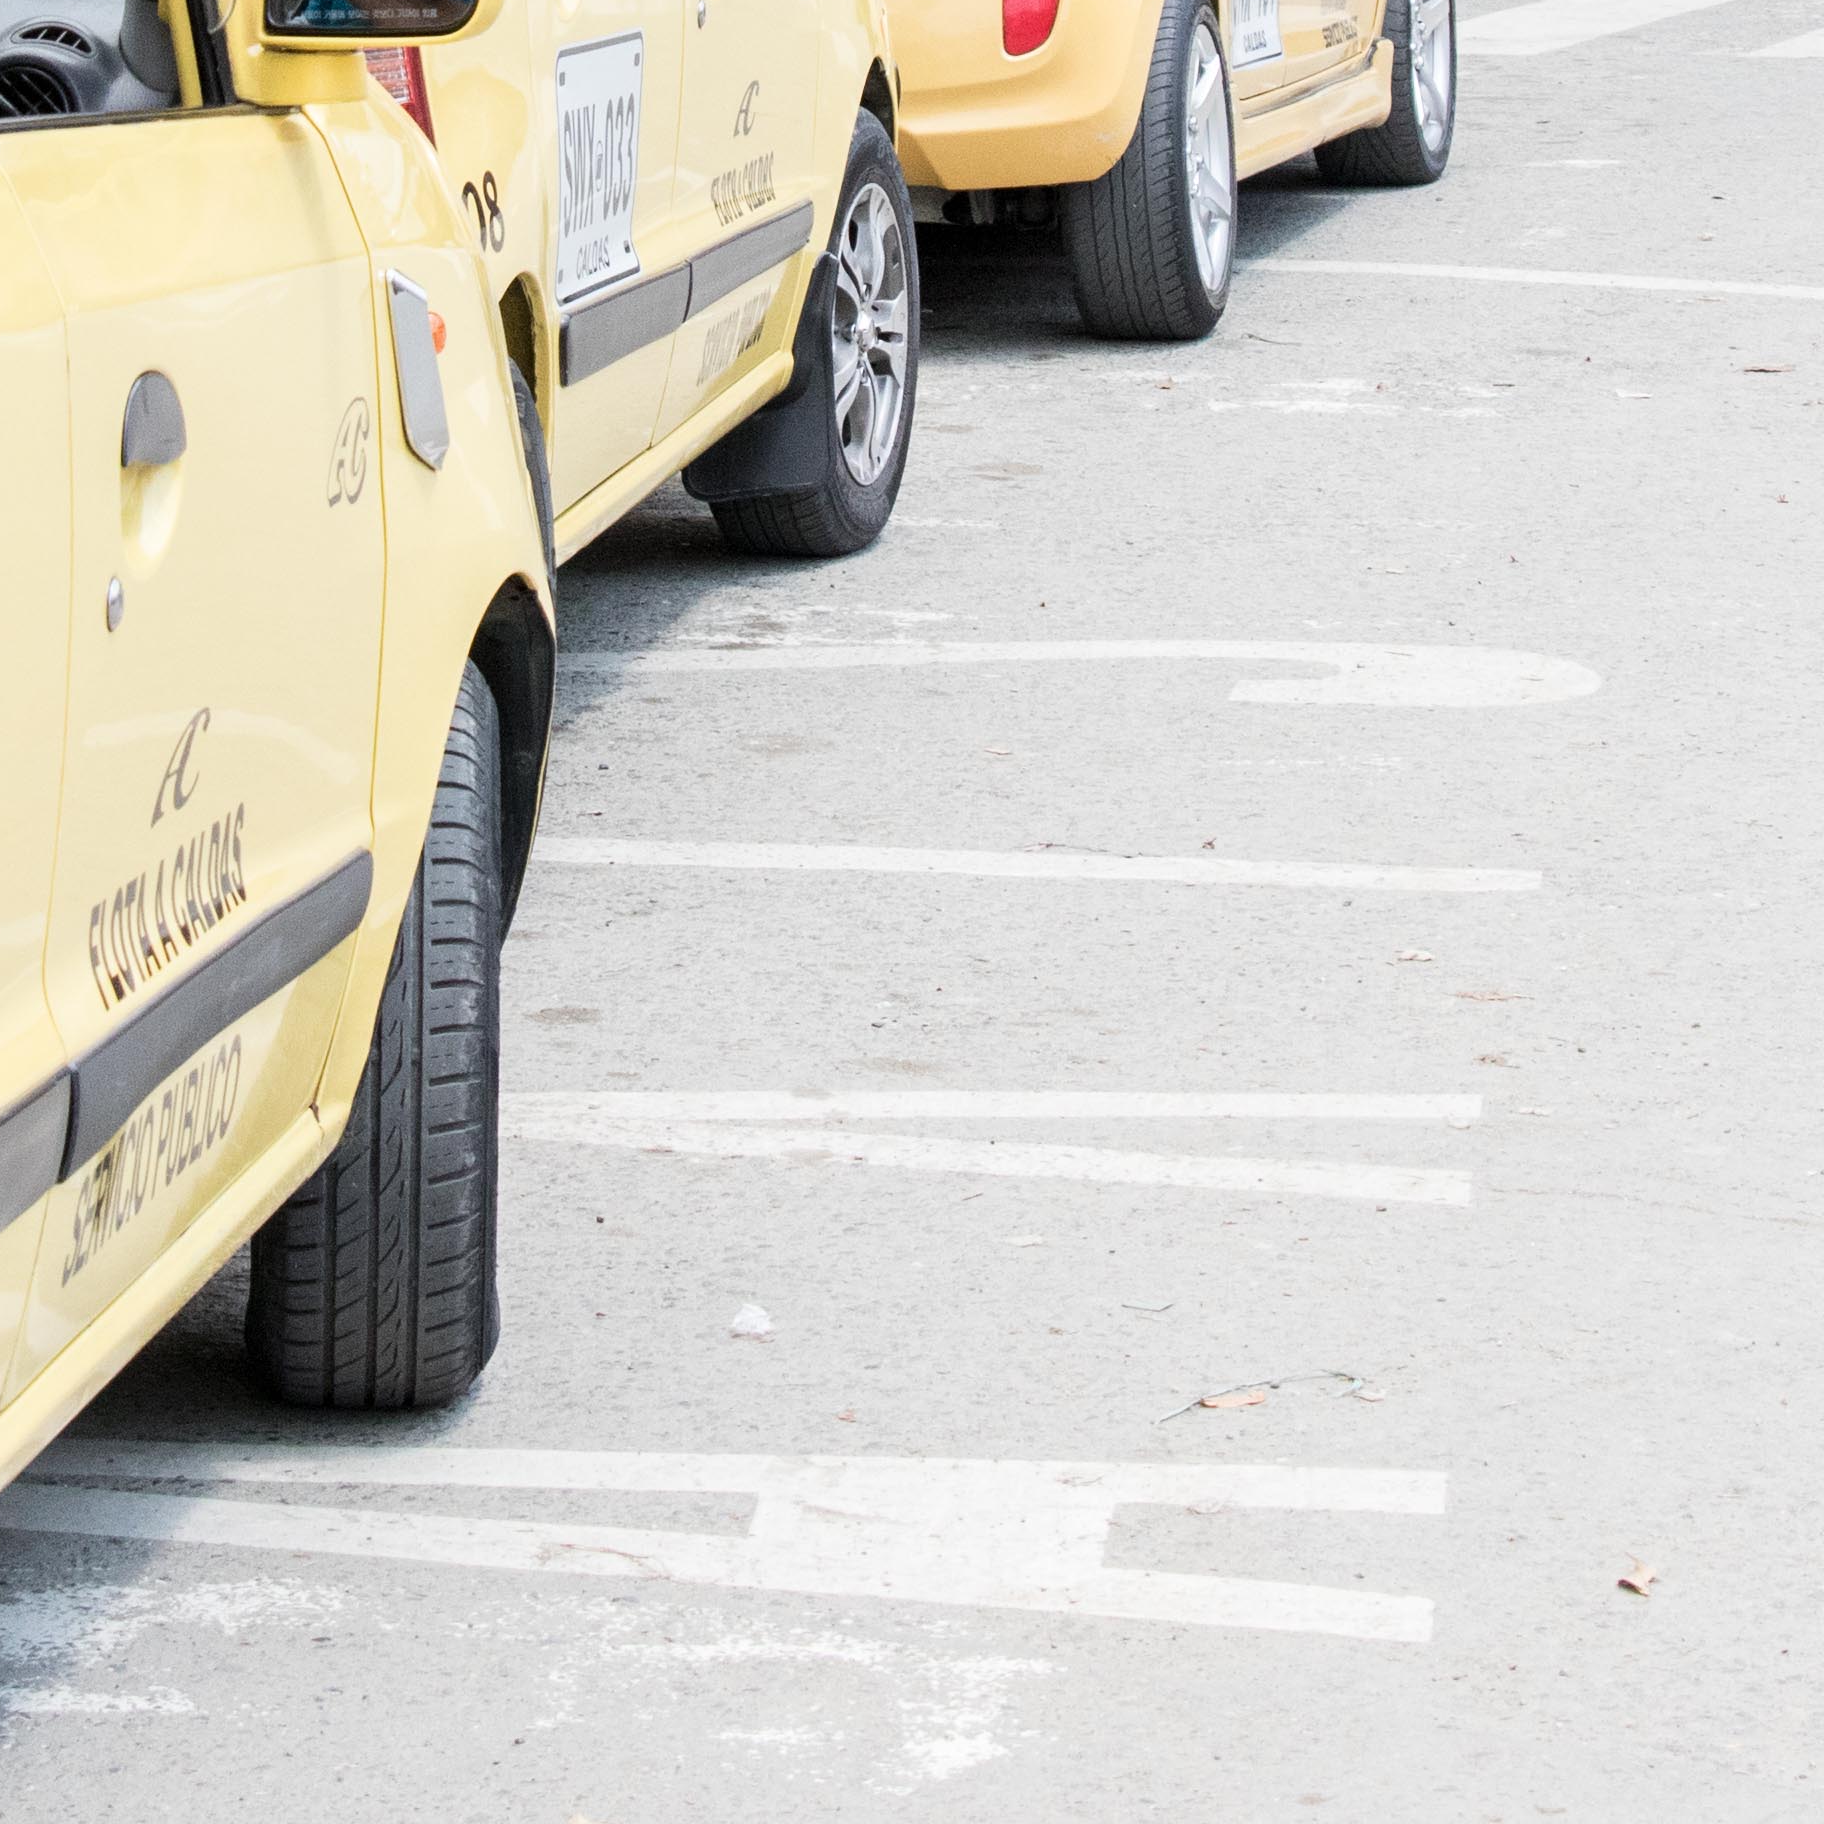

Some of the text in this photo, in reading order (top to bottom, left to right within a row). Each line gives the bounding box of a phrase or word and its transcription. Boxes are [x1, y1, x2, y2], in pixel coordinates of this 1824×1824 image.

[576, 235, 612, 281] CALDAS
[88, 800, 248, 1012] FLOTA A CALDAS
[61, 1033, 242, 1289] SERVICIO PUBLICO
